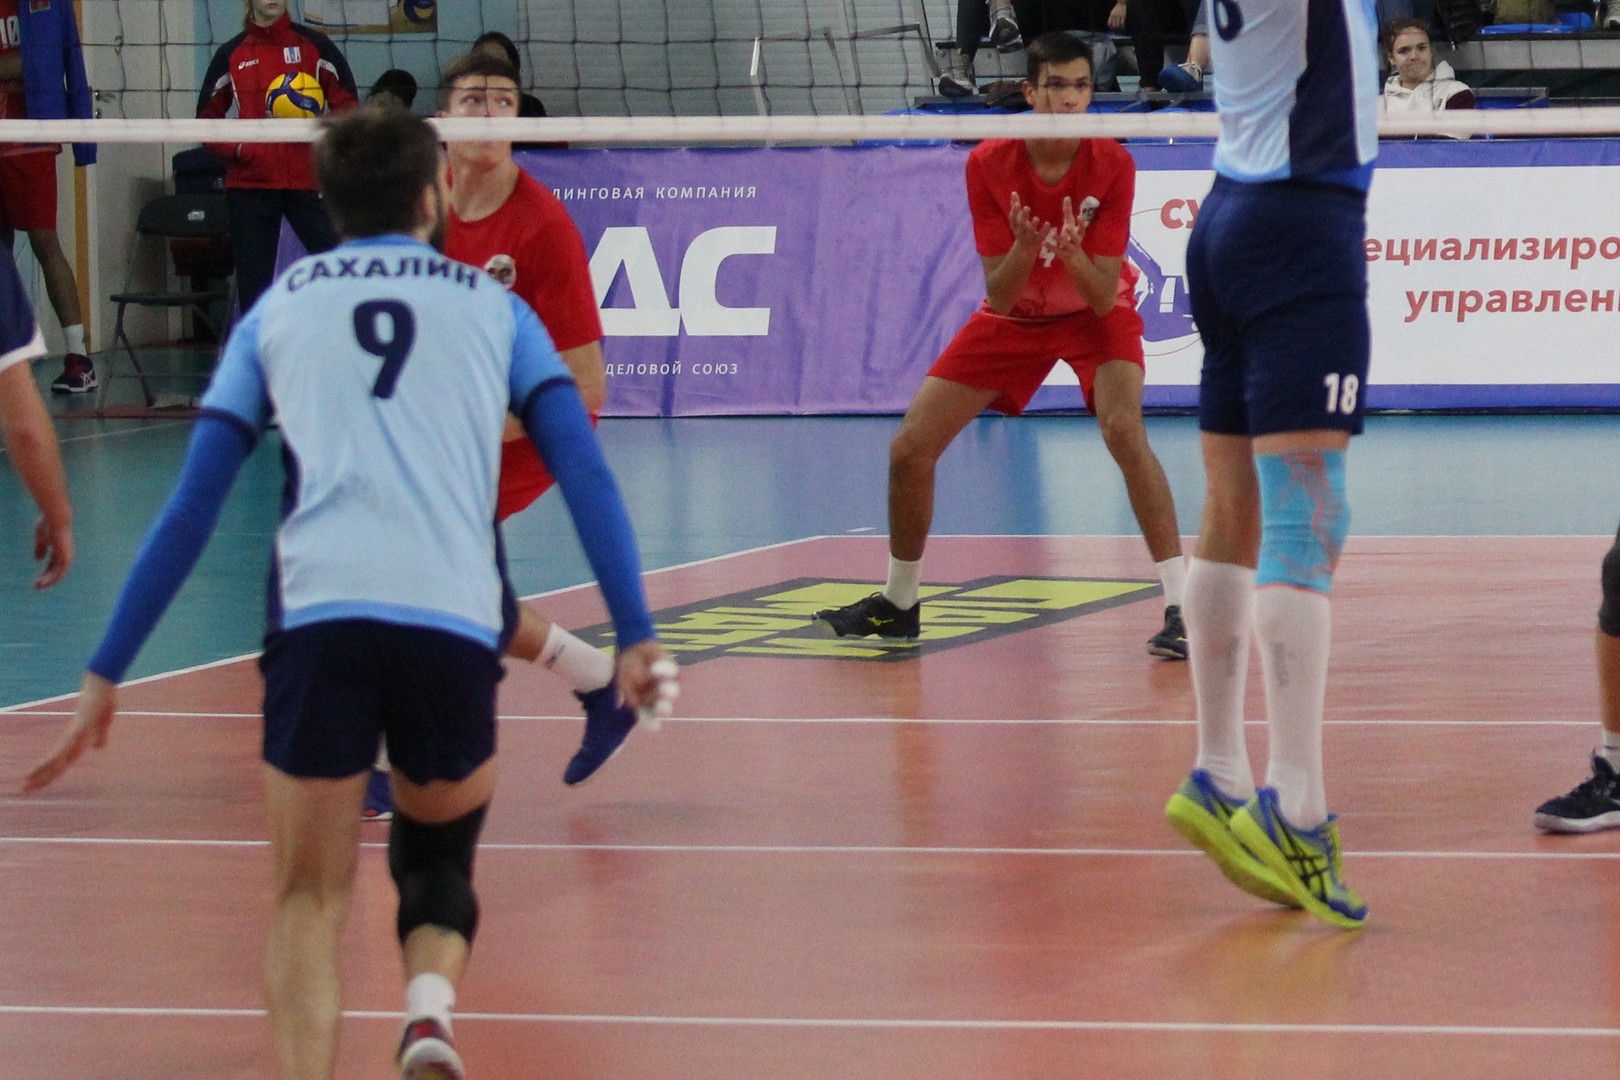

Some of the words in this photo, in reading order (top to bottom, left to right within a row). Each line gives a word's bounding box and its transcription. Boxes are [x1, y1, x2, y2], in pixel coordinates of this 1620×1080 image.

[553, 187, 645, 200] ДИНГОВАЯ
[656, 186, 757, 199] КОМПАНИЯ
[288, 256, 480, 292] САХАЛИН
[353, 298, 418, 400] 9
[605, 361, 682, 376] ДЕЛОВОЙ
[692, 363, 738, 375] СОЮЗ
[1324, 372, 1359, 415] 18
